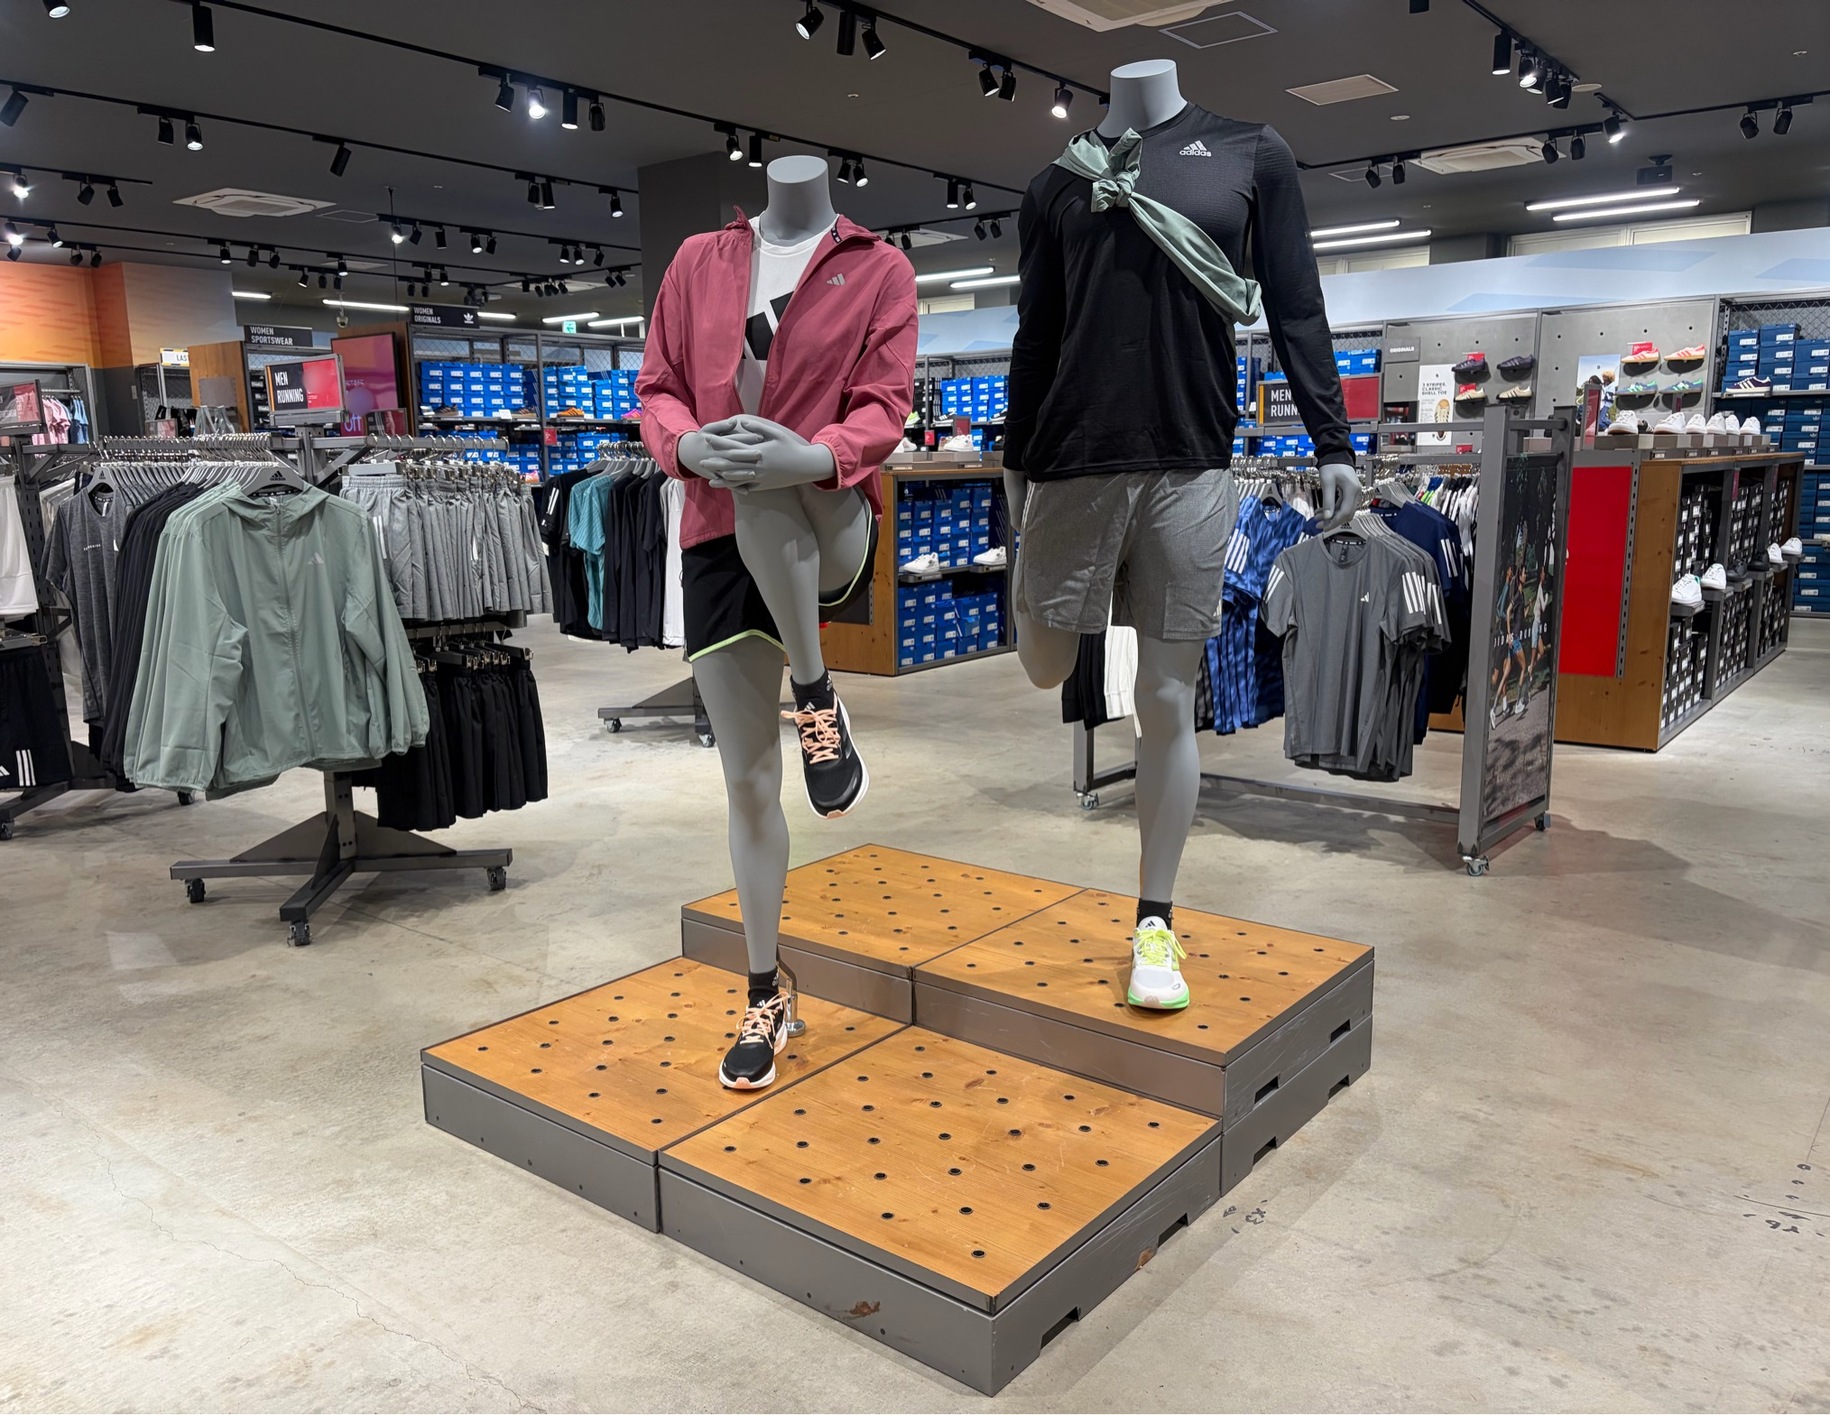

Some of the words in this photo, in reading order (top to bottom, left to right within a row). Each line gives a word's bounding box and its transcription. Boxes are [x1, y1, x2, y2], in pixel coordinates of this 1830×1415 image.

[414, 307, 434, 315] WOMEN
[414, 315, 441, 324] ORIGINALS
[250, 326, 274, 335] WOMEN
[251, 335, 294, 346] SPORTSWEAR
[274, 371, 289, 386] MEN
[277, 388, 304, 404] RUNNING
[1271, 389, 1292, 402] MEN
[1271, 403, 1300, 417] RUNN
